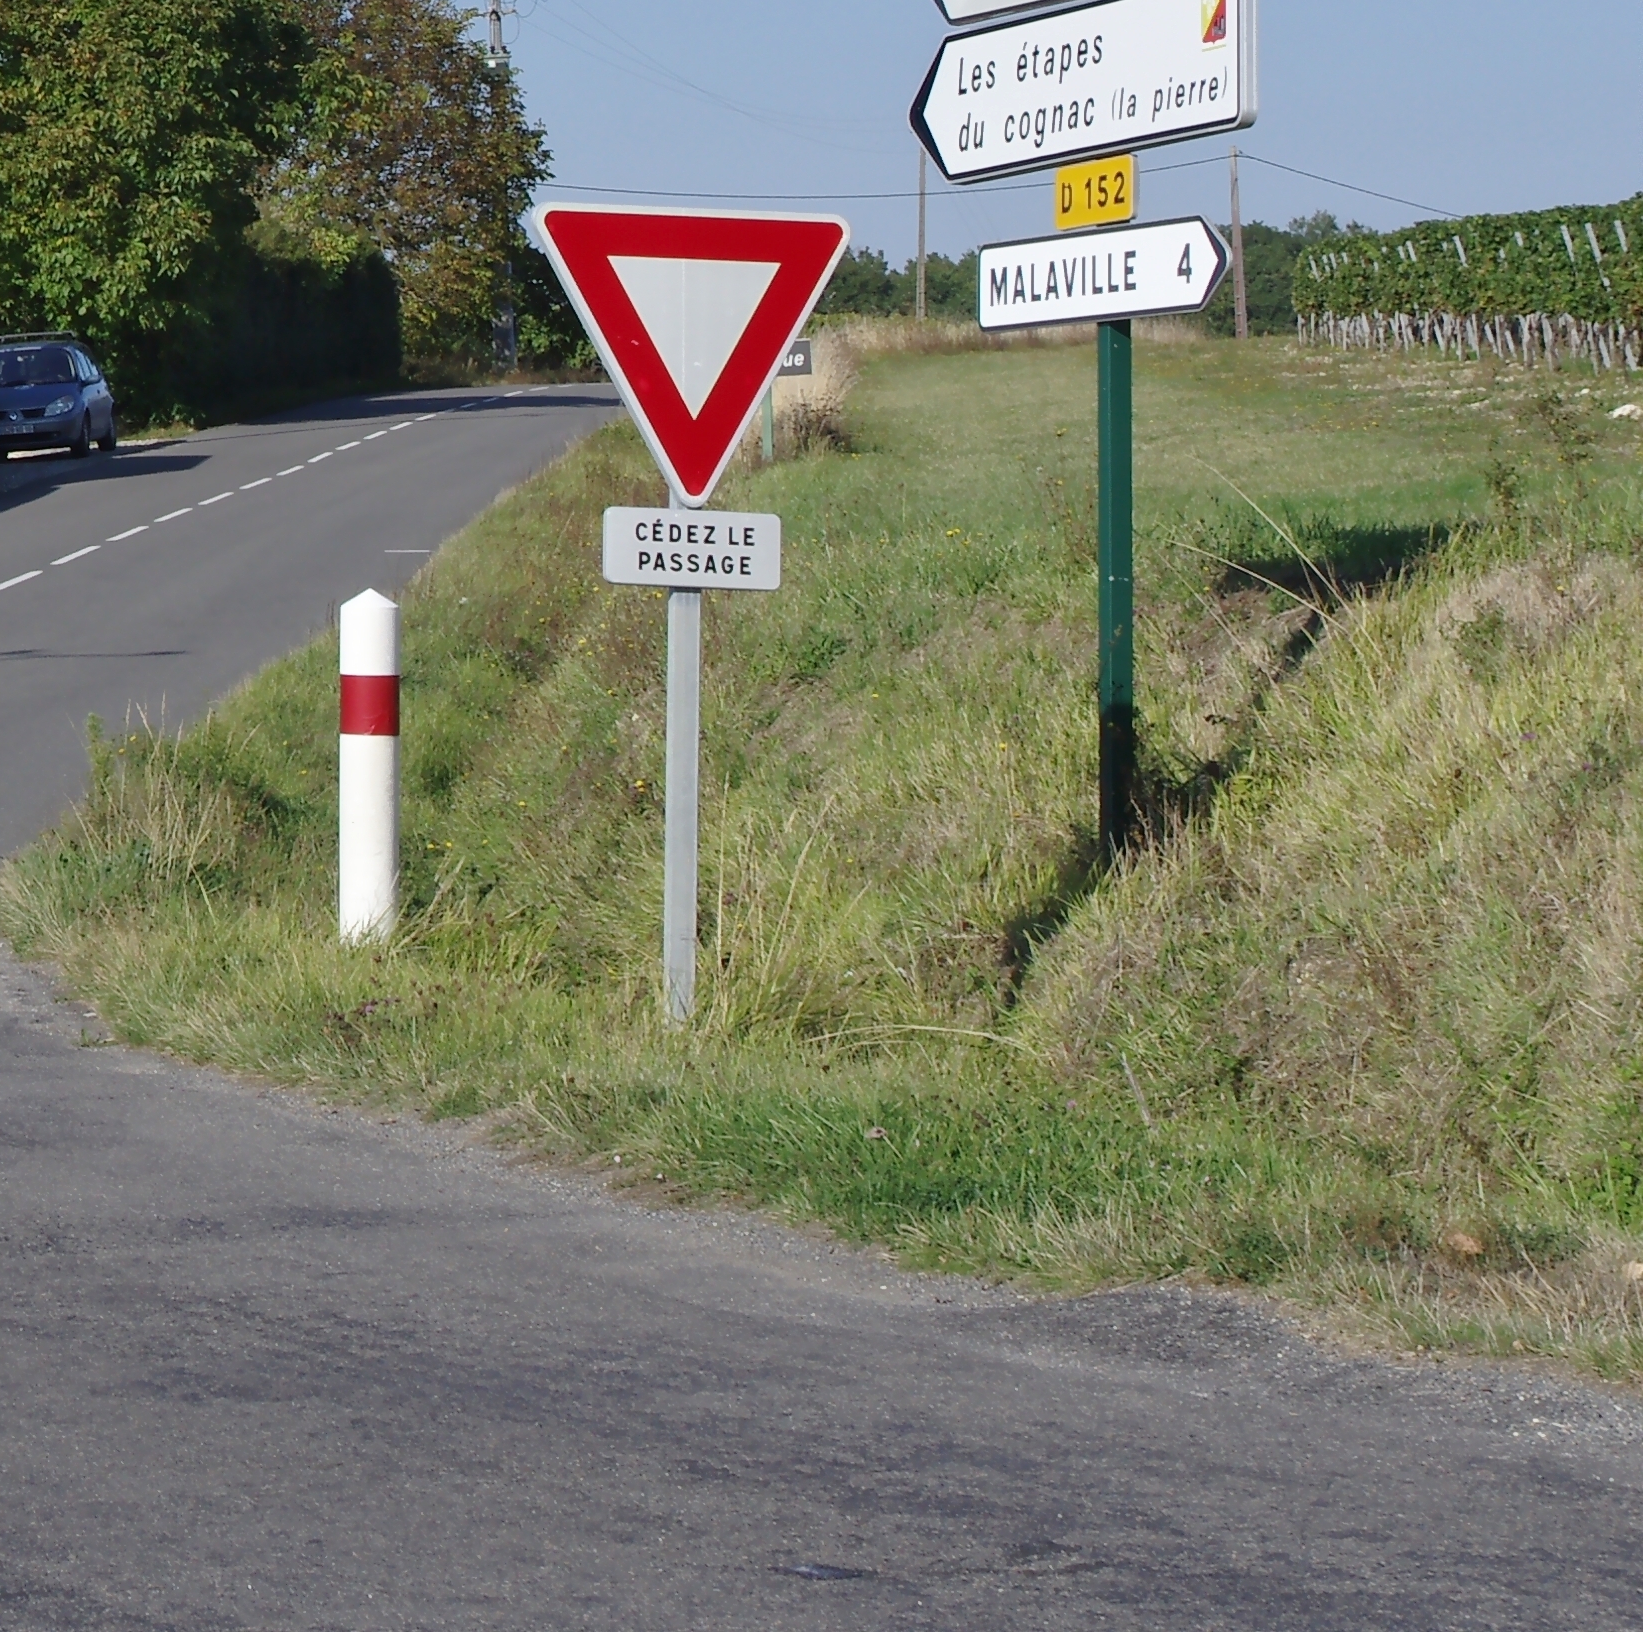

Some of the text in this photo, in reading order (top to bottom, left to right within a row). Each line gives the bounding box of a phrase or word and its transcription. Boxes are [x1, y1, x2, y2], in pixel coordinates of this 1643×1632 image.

[958, 34, 1103, 96] Les étapes
[958, 66, 1227, 152] du cognac (la pierre)
[1061, 171, 1125, 213] D 152
[990, 243, 1192, 306] MALAVILLE 4
[635, 519, 755, 546] CÉDEZ LE
[638, 551, 752, 576] PASSAGE
